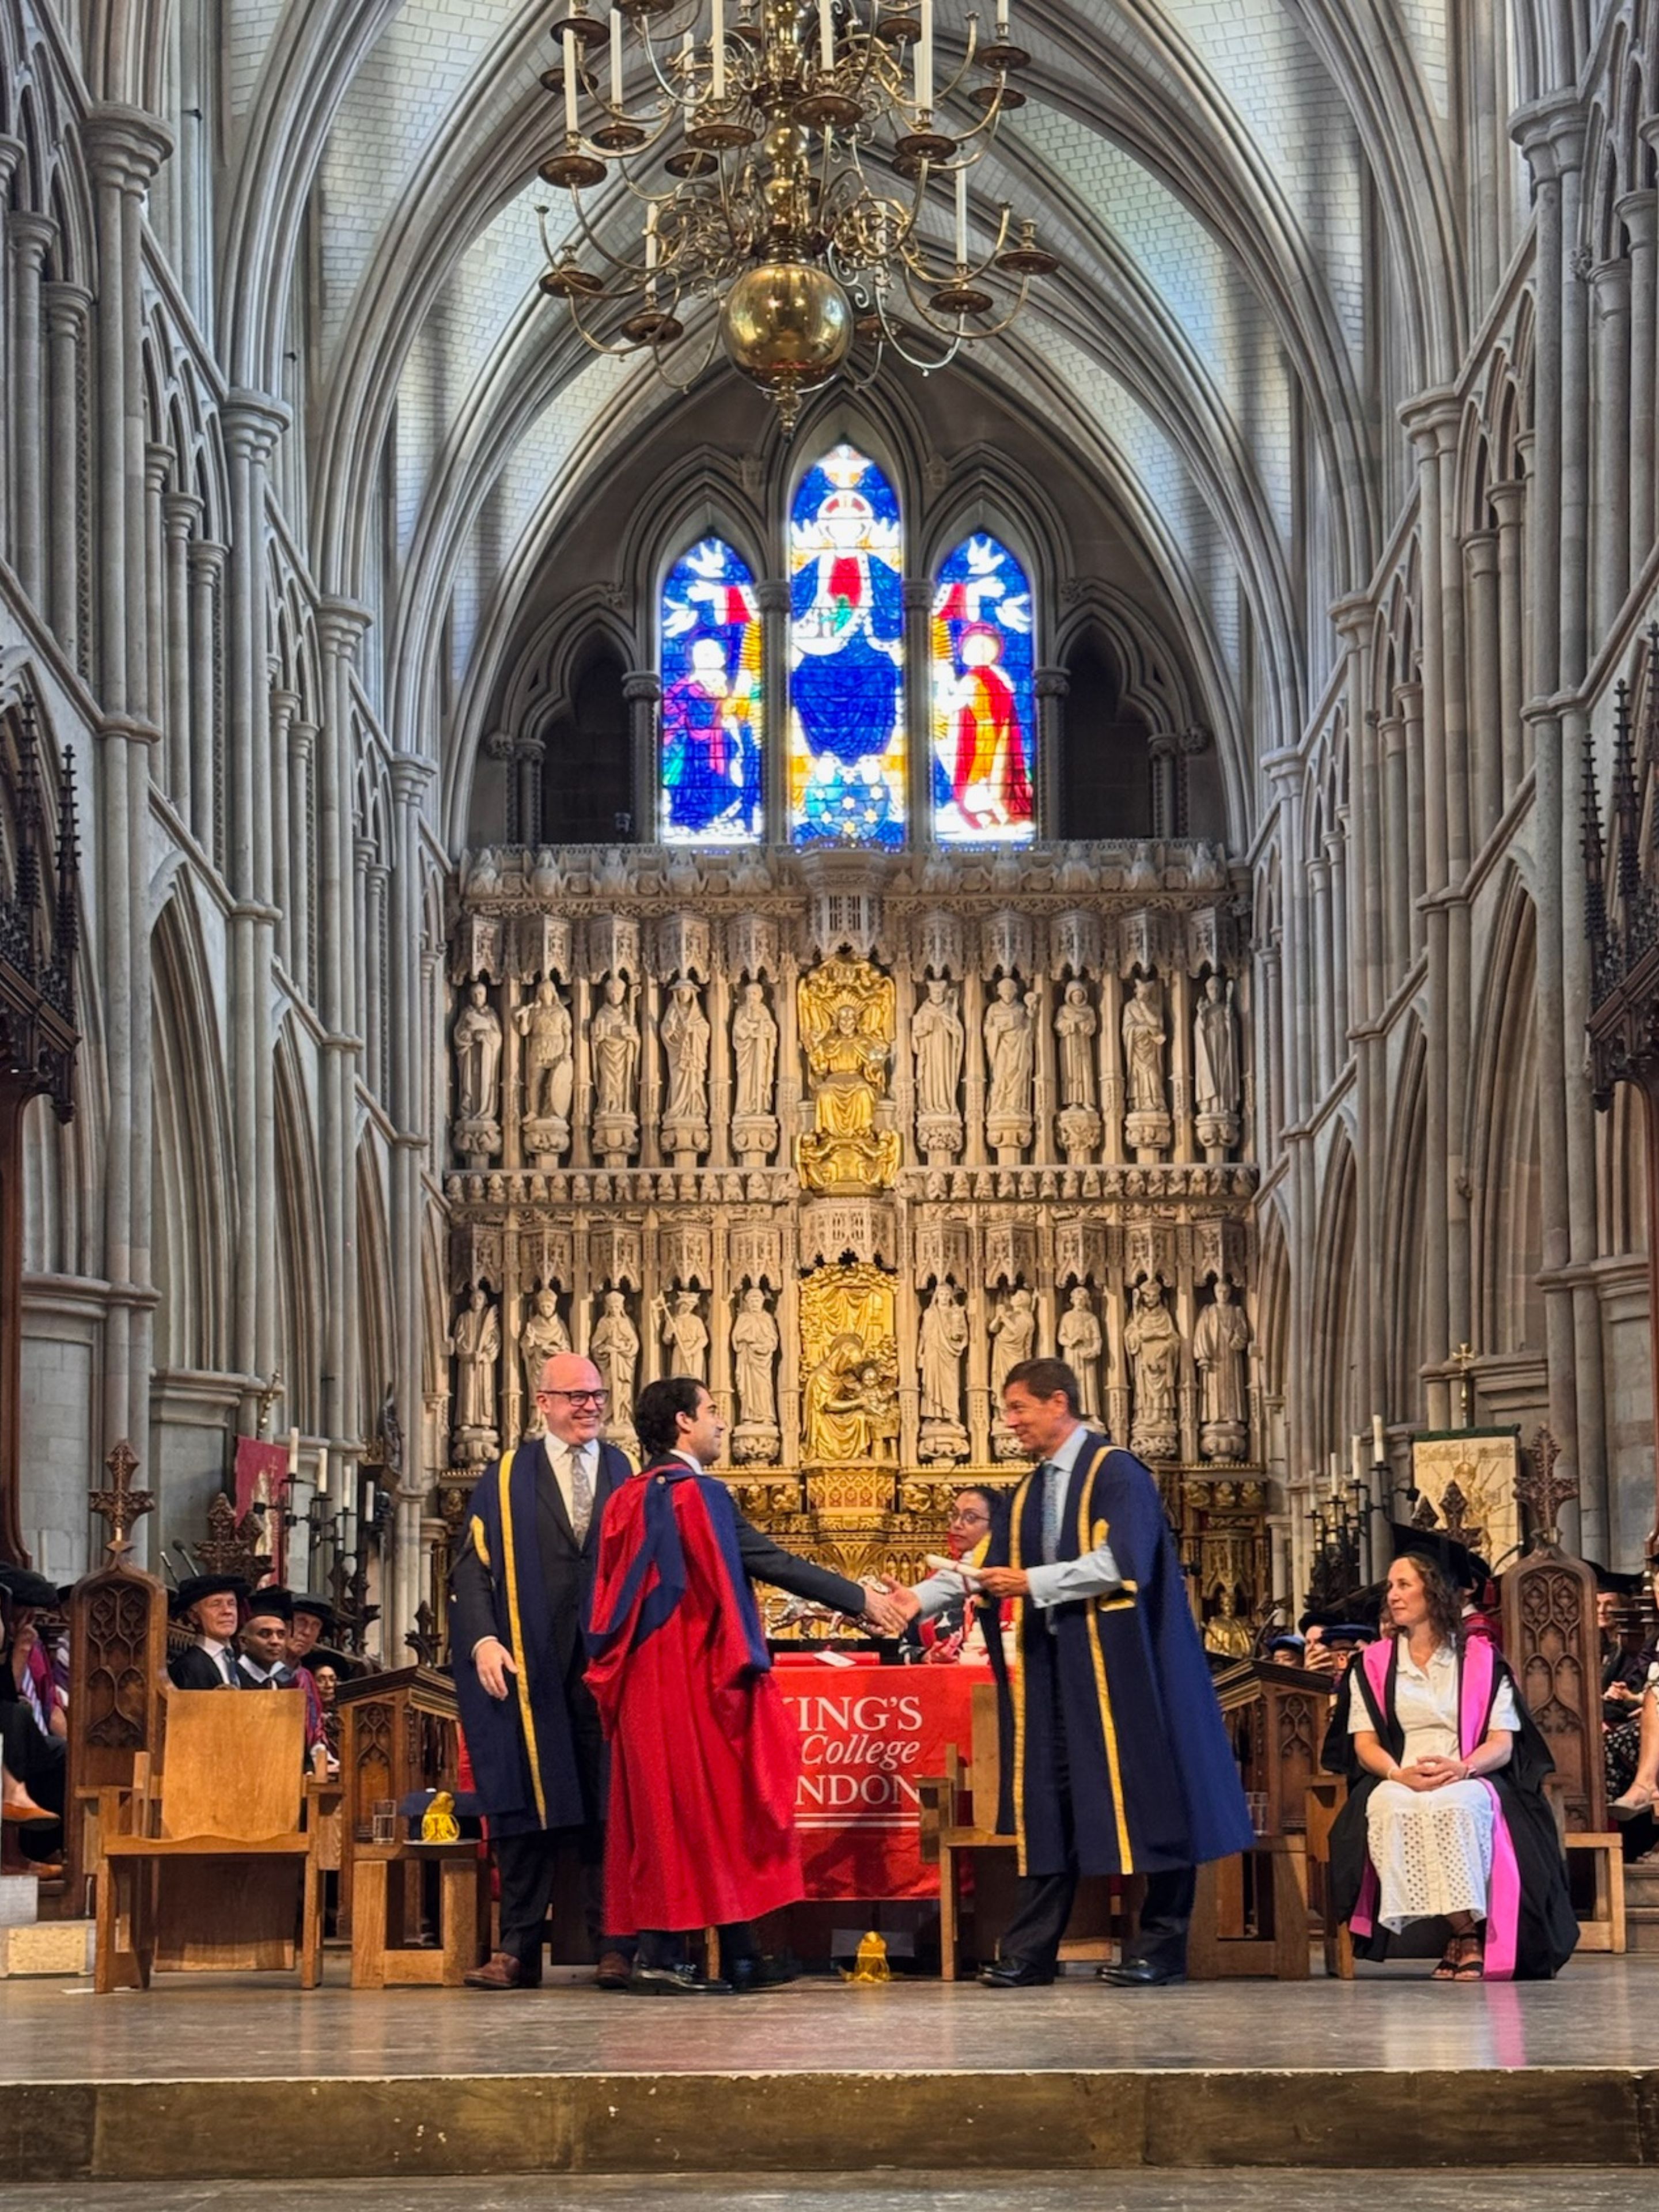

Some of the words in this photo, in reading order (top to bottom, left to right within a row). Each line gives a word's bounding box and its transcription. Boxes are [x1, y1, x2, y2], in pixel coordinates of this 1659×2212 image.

[783, 1696, 922, 1731] ING'S
[802, 1734, 921, 1770] College
[794, 1774, 923, 1805] NDON
